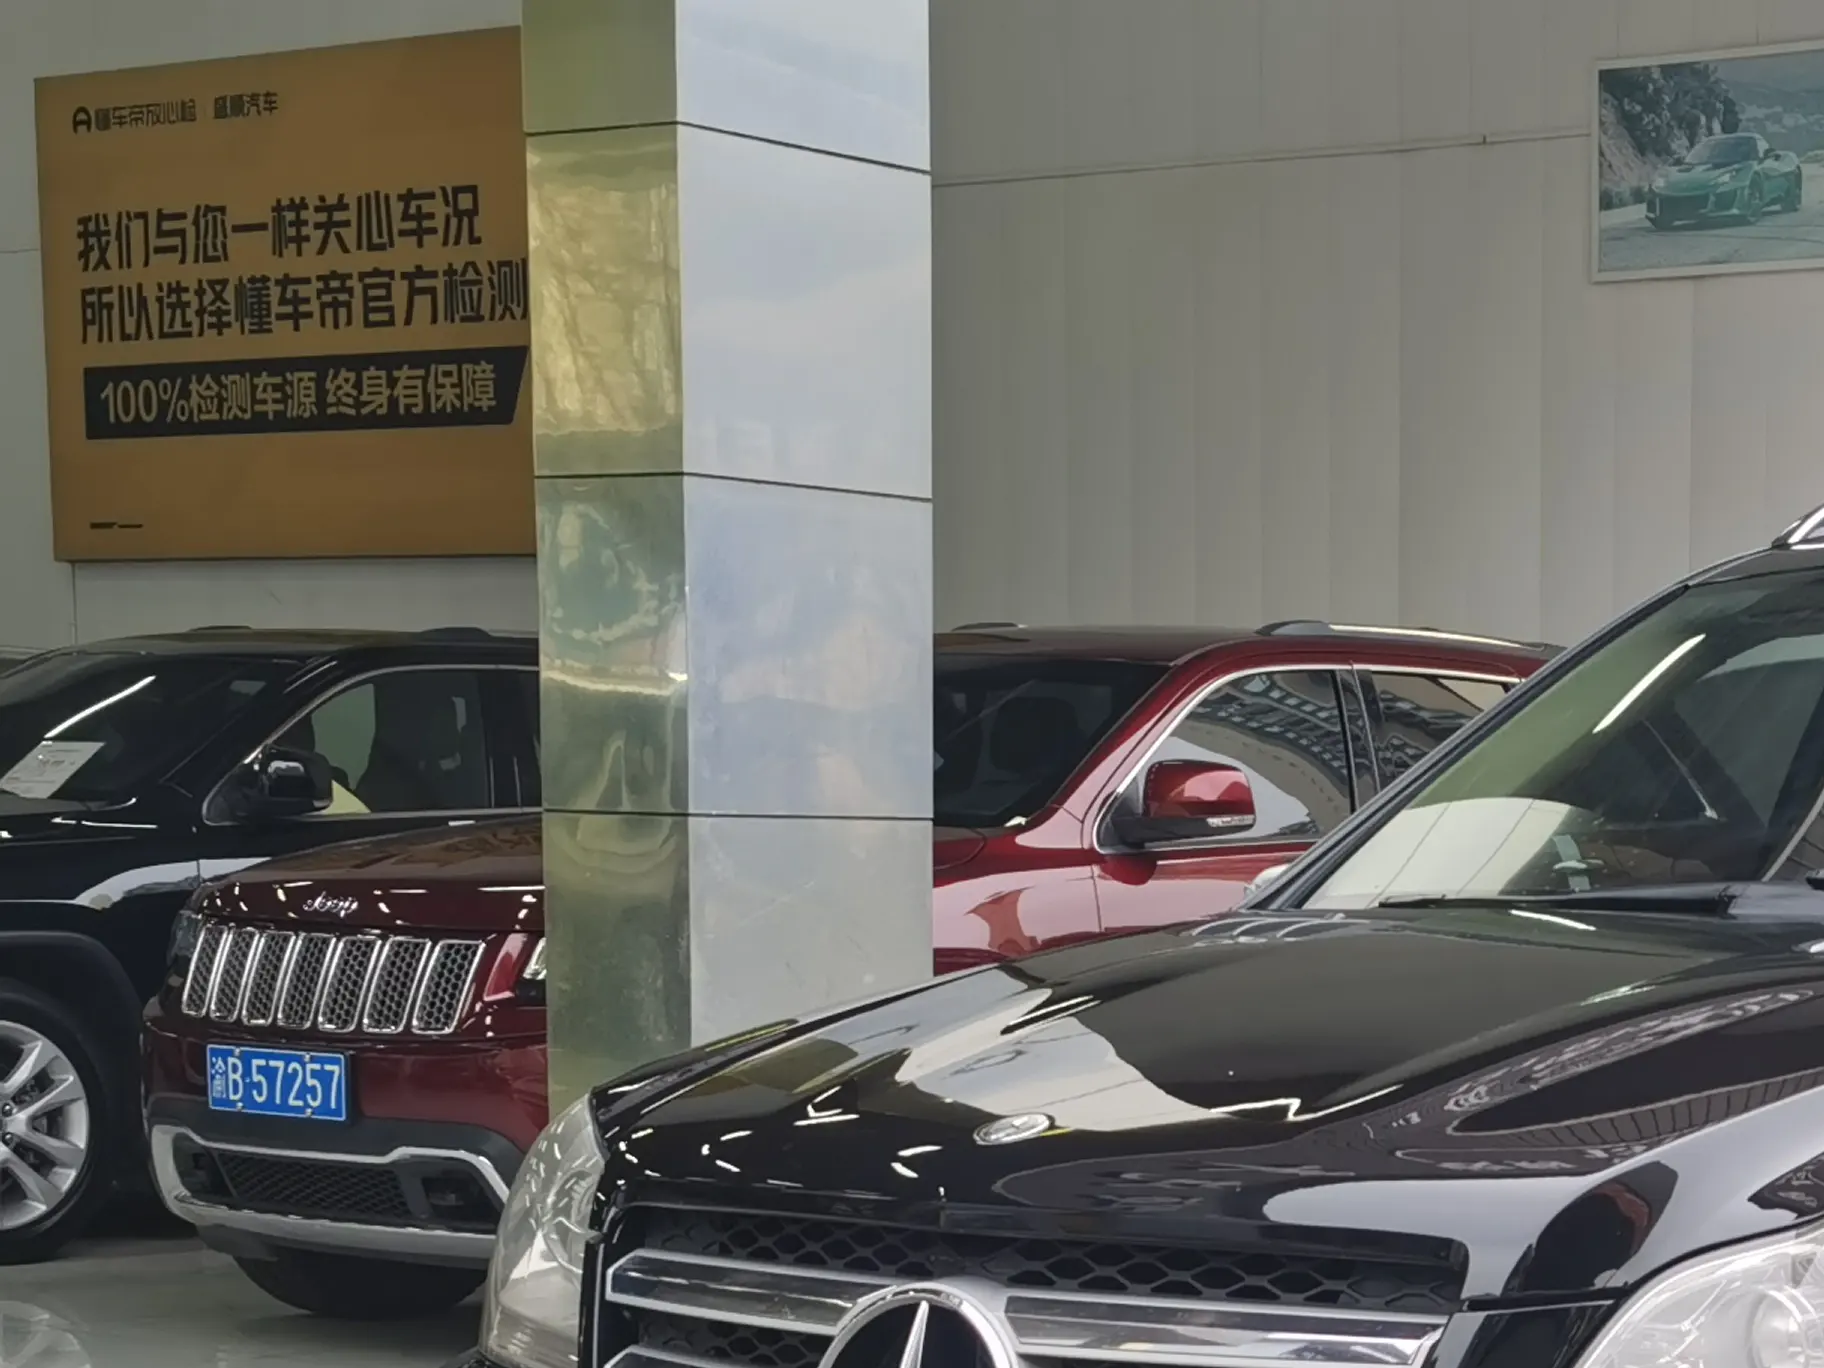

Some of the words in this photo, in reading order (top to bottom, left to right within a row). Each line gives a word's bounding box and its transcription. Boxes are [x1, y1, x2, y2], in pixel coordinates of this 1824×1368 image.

[76, 184, 482, 273] 我们与您一样关心车况
[80, 257, 528, 345] 所以选择懂车帝官方检测
[100, 369, 318, 424] 100%检测车源
[324, 360, 498, 418] 终身有保障
